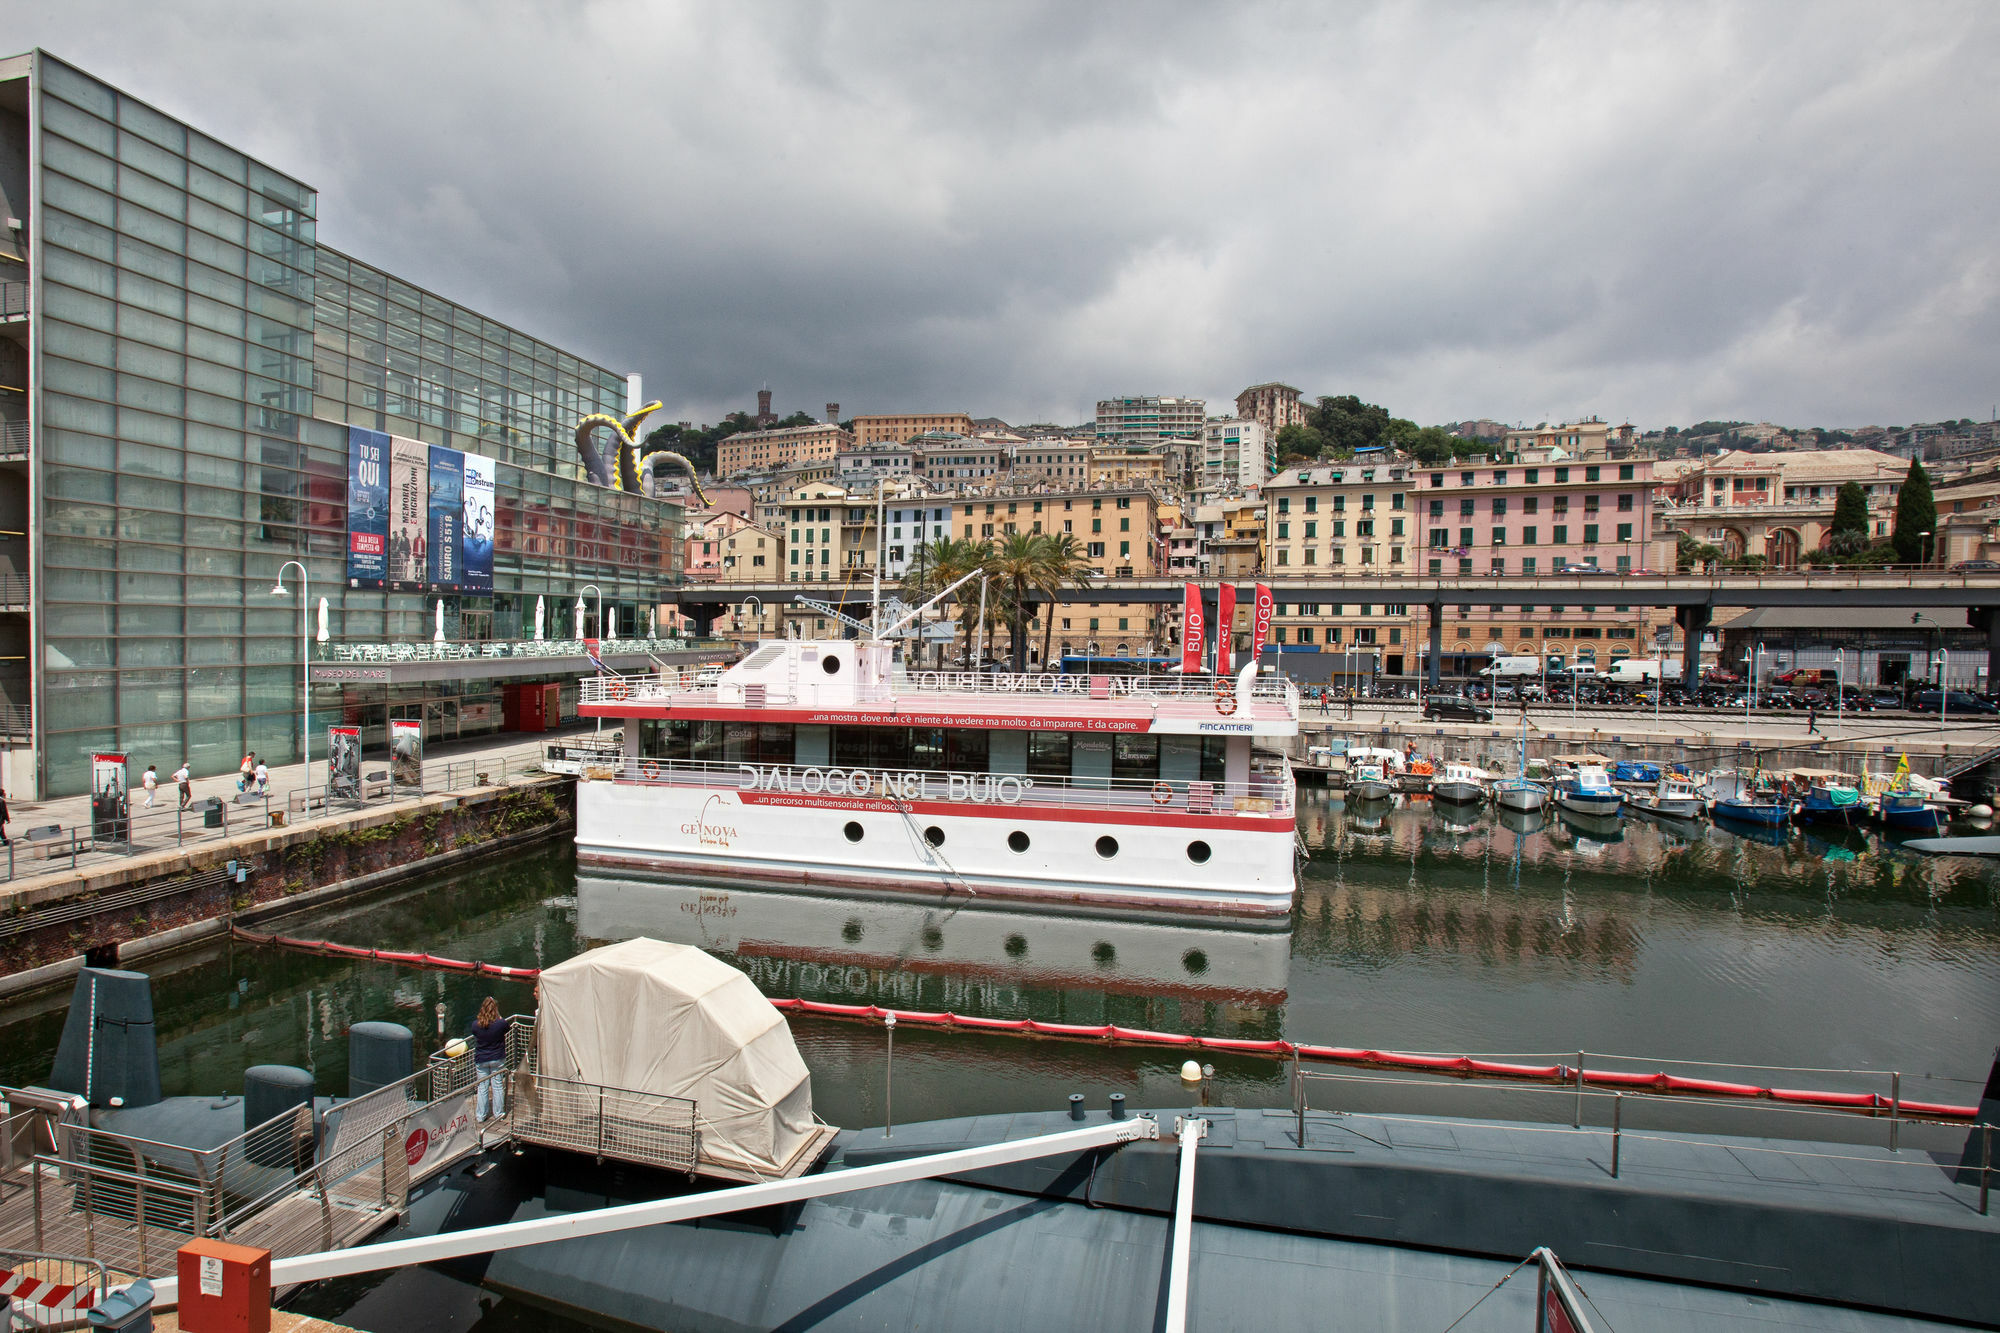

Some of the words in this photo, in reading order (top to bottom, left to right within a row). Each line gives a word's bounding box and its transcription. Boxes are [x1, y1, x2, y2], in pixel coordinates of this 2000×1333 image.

[360, 444, 369, 459] TU
[370, 446, 380, 462] SEI
[359, 460, 380, 487] QUI
[466, 476, 495, 488] Monstrum
[402, 482, 410, 524] MEMORIA
[410, 467, 418, 519] MIGRAZIONI
[444, 515, 453, 544] S518
[444, 545, 453, 581] SAURO
[315, 670, 344, 679] MUSEO
[346, 670, 362, 679] DEL
[363, 670, 386, 679] MARE
[860, 714, 881, 723] dove
[914, 715, 941, 725] niente
[942, 716, 953, 725] da
[955, 716, 984, 726] vedere
[985, 718, 1000, 726] ma
[1001, 717, 1028, 727] molto
[1029, 718, 1041, 727] da
[1042, 719, 1084, 730] imparare.
[1087, 720, 1093, 728] E
[1094, 720, 1107, 729] da
[1108, 721, 1139, 731] capire.
[1199, 723, 1253, 732] FINCANTIERI
[738, 765, 871, 797] DIALOGO
[770, 797, 804, 808] percorso
[804, 798, 864, 810] multisensoriale
[865, 801, 914, 813] nell'oscuità
[430, 1114, 468, 1141] GALATA
